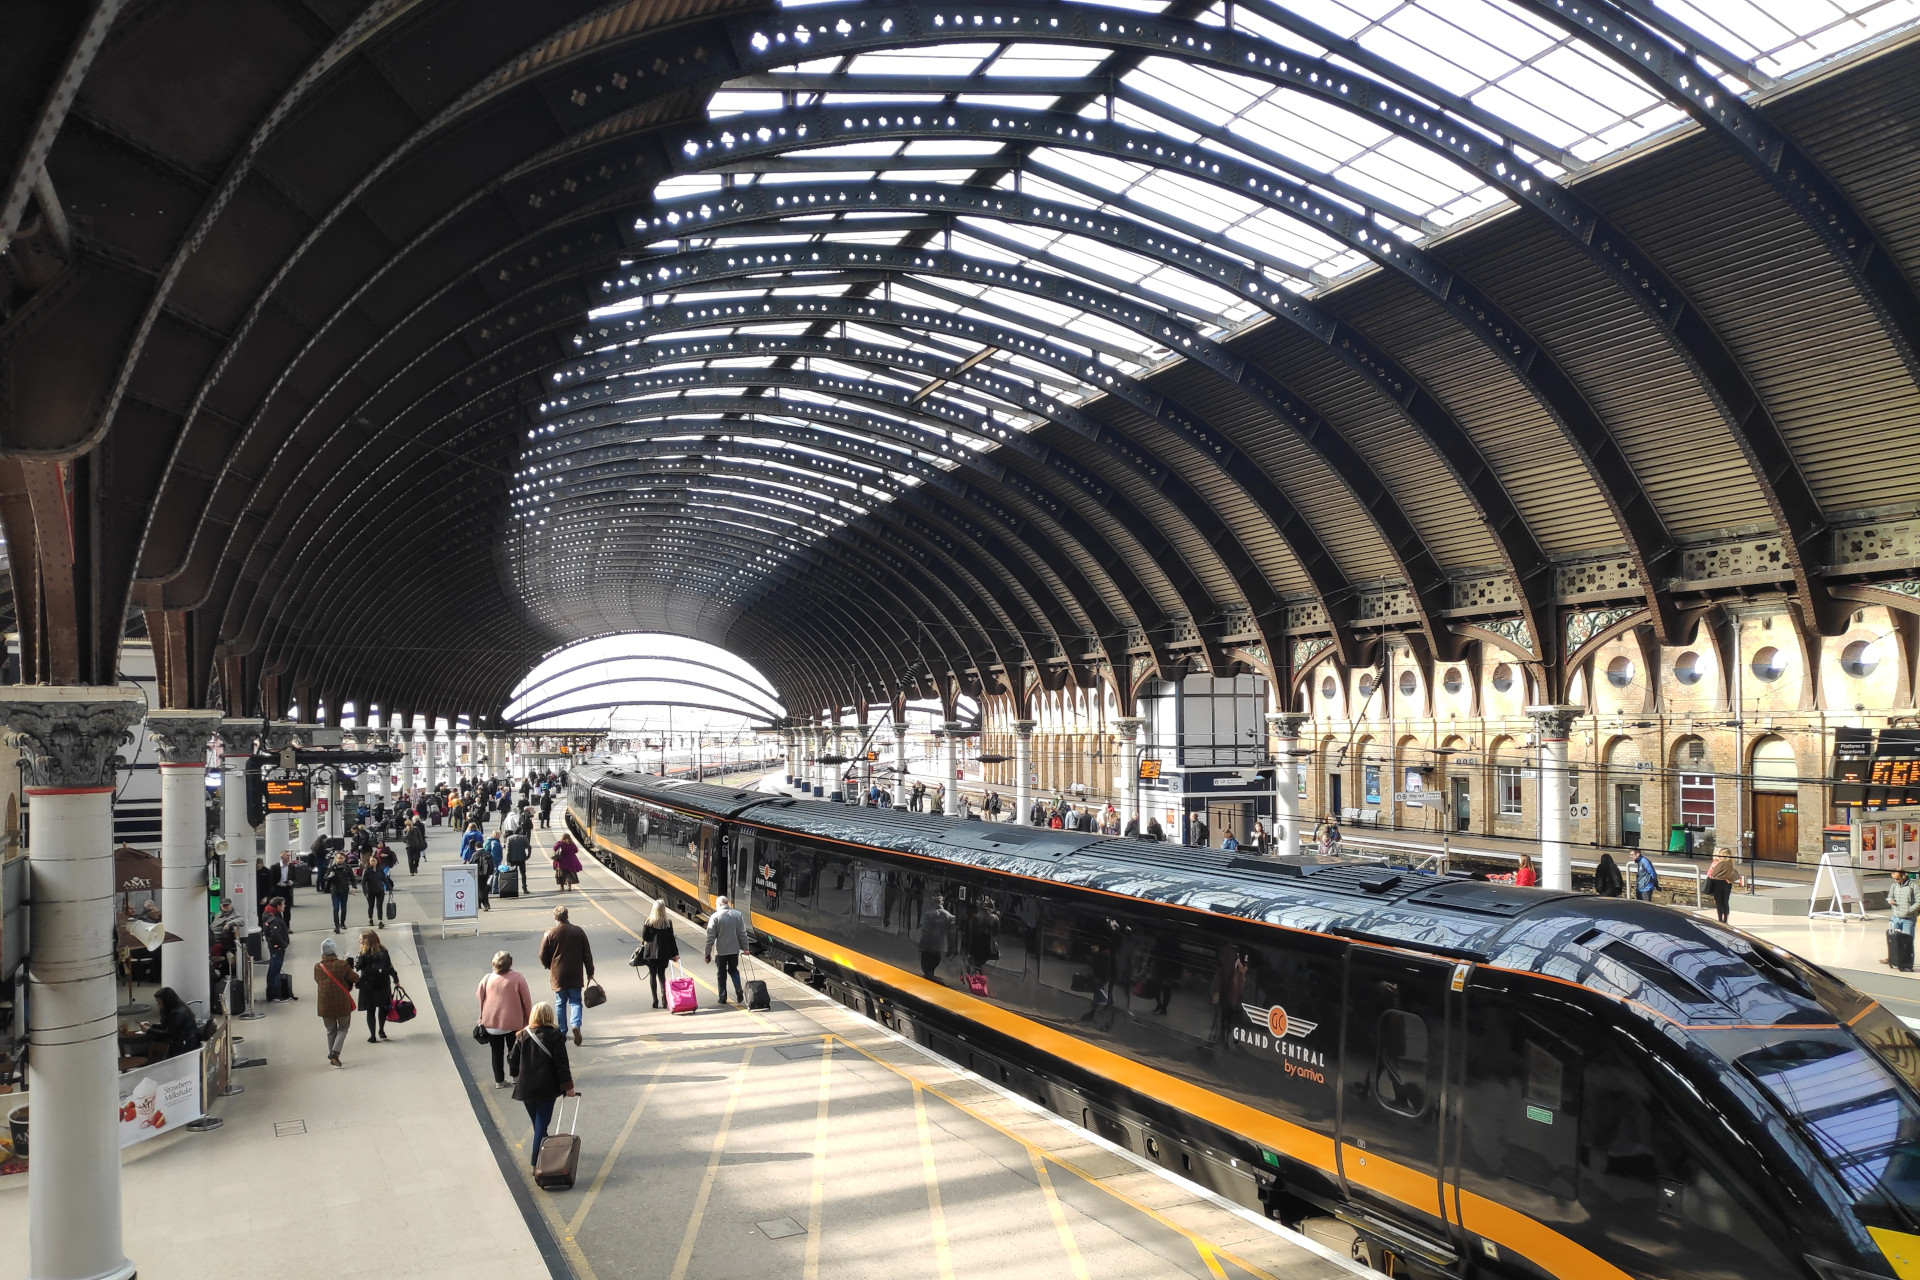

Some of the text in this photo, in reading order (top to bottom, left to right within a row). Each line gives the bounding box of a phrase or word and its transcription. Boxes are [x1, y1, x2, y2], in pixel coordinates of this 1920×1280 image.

[1173, 781, 1178, 790] 5
[123, 878, 151, 887] AMT
[1233, 1027, 1325, 1067] GRAND CENTRAL
[1284, 1058, 1324, 1084] by arriva
[163, 1080, 193, 1095] Strawberry
[164, 1087, 193, 1102] Milkshake
